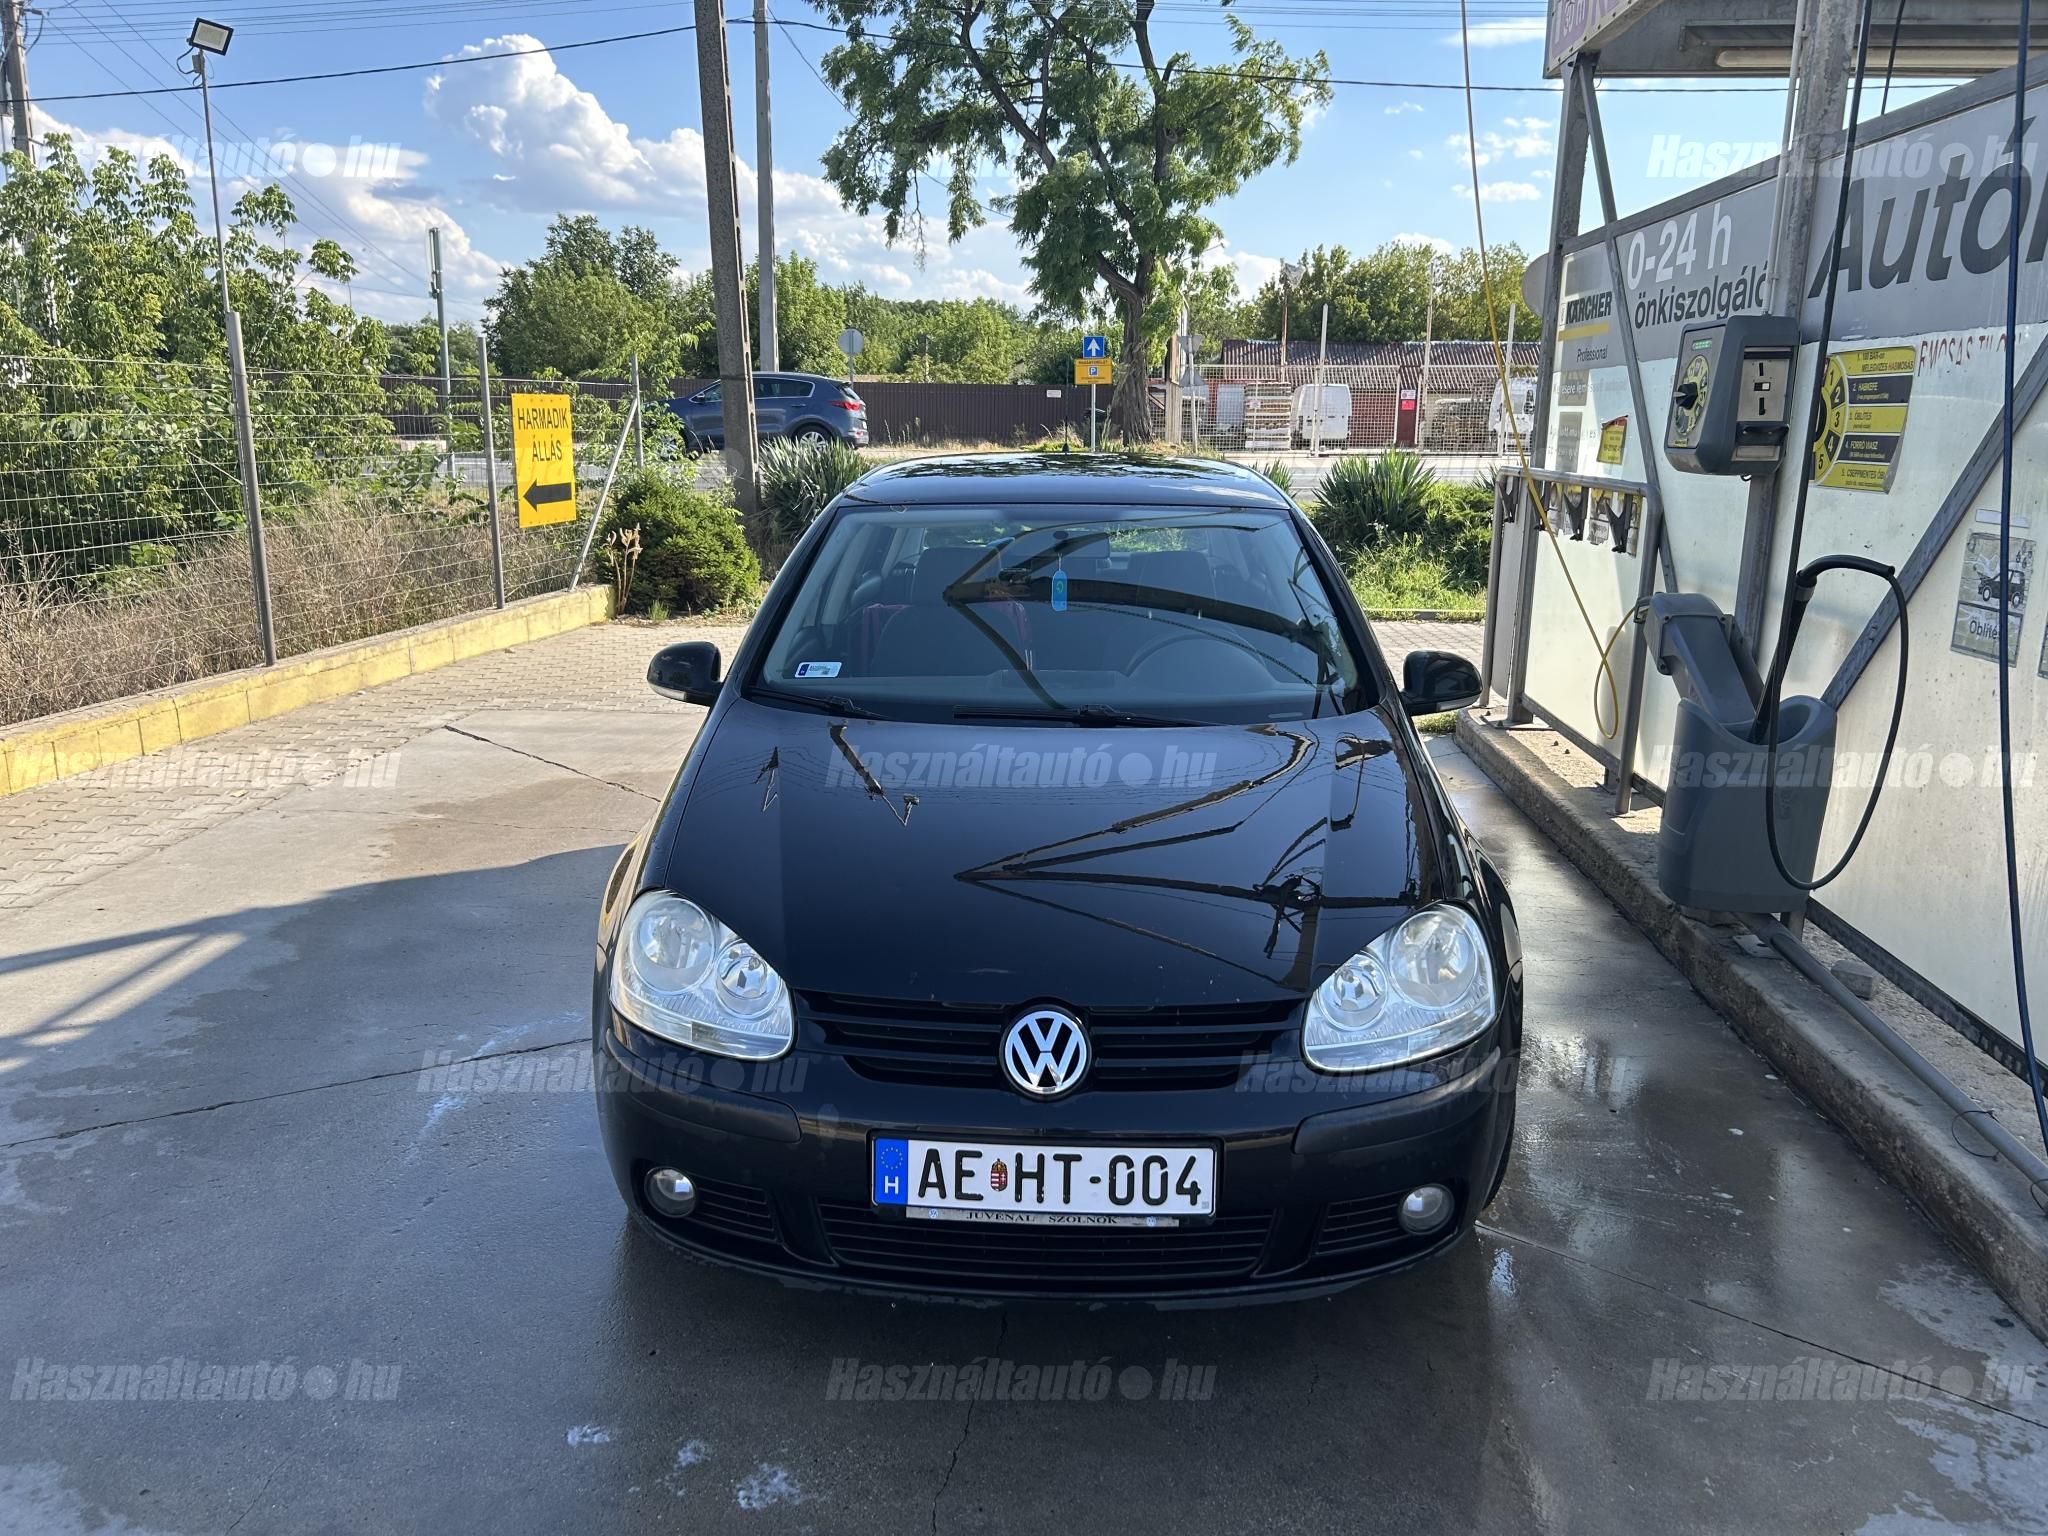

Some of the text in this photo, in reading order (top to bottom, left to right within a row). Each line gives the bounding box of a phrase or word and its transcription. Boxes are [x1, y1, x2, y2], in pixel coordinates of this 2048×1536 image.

[1807, 115, 2048, 299] Autó
[1627, 202, 1732, 290] 0-24 h
[1634, 261, 1769, 329] önkiszolgáló
[1576, 345, 1609, 363] Professional
[1829, 369, 1834, 386] 1
[1834, 386, 1841, 403] 2
[517, 407, 569, 430] HARMADIK
[1834, 411, 1840, 428] 3
[532, 434, 562, 463] ÁLLÁS
[1827, 436, 1834, 451] 4
[1818, 453, 1824, 470] 5
[884, 1176, 899, 1195] H
[1048, 1215, 1119, 1225] SZOLNOK
